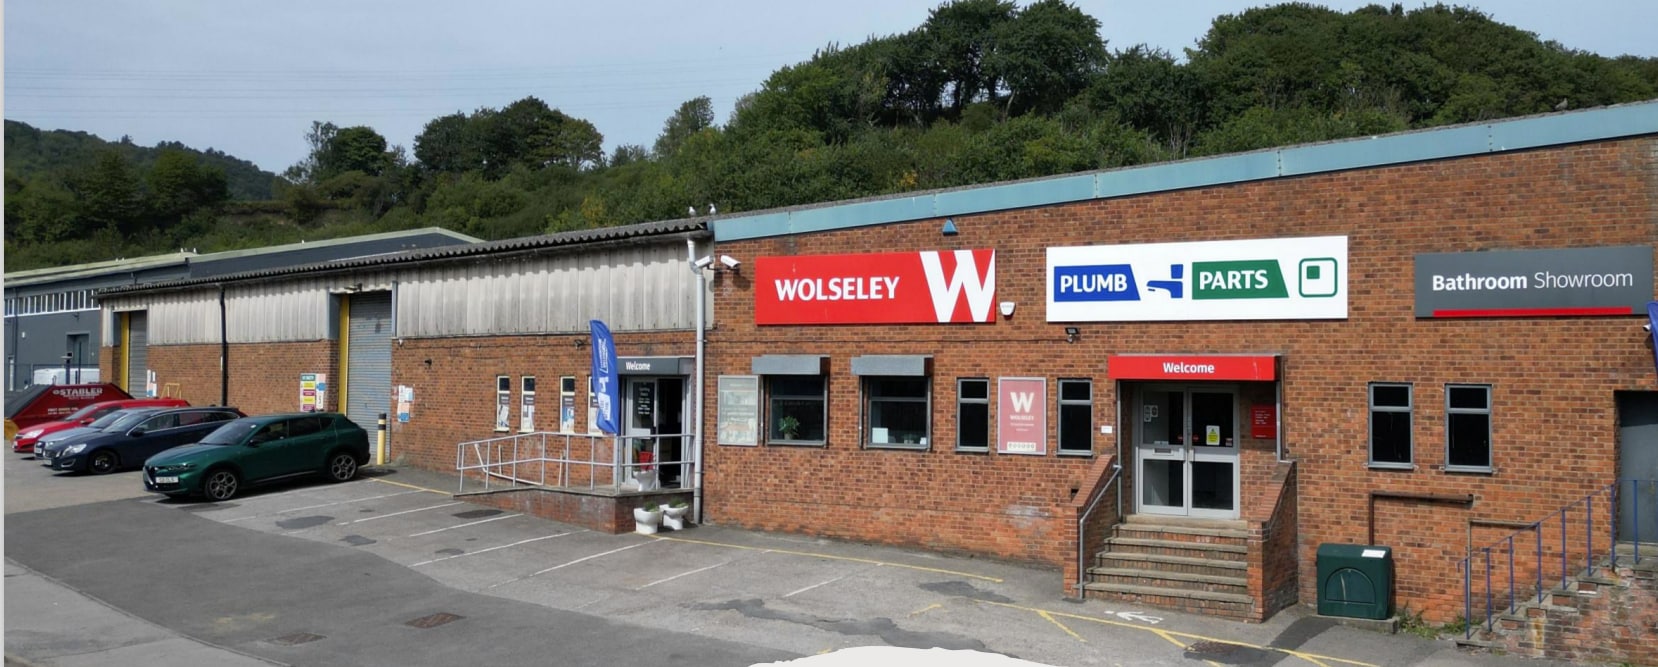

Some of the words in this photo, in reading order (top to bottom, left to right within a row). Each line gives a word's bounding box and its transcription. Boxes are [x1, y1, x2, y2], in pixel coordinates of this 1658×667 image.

[774, 276, 900, 301] WOLSELEY
[919, 248, 996, 323] W
[1060, 273, 1128, 293] PLUMB
[1199, 269, 1269, 290] PARTS
[1432, 272, 1528, 291] Bathroom
[1534, 271, 1633, 289] Showroom
[625, 361, 651, 371] Welcome
[1163, 362, 1215, 374] Welcome
[60, 387, 103, 396] STABLER
[1010, 391, 1035, 413] W
